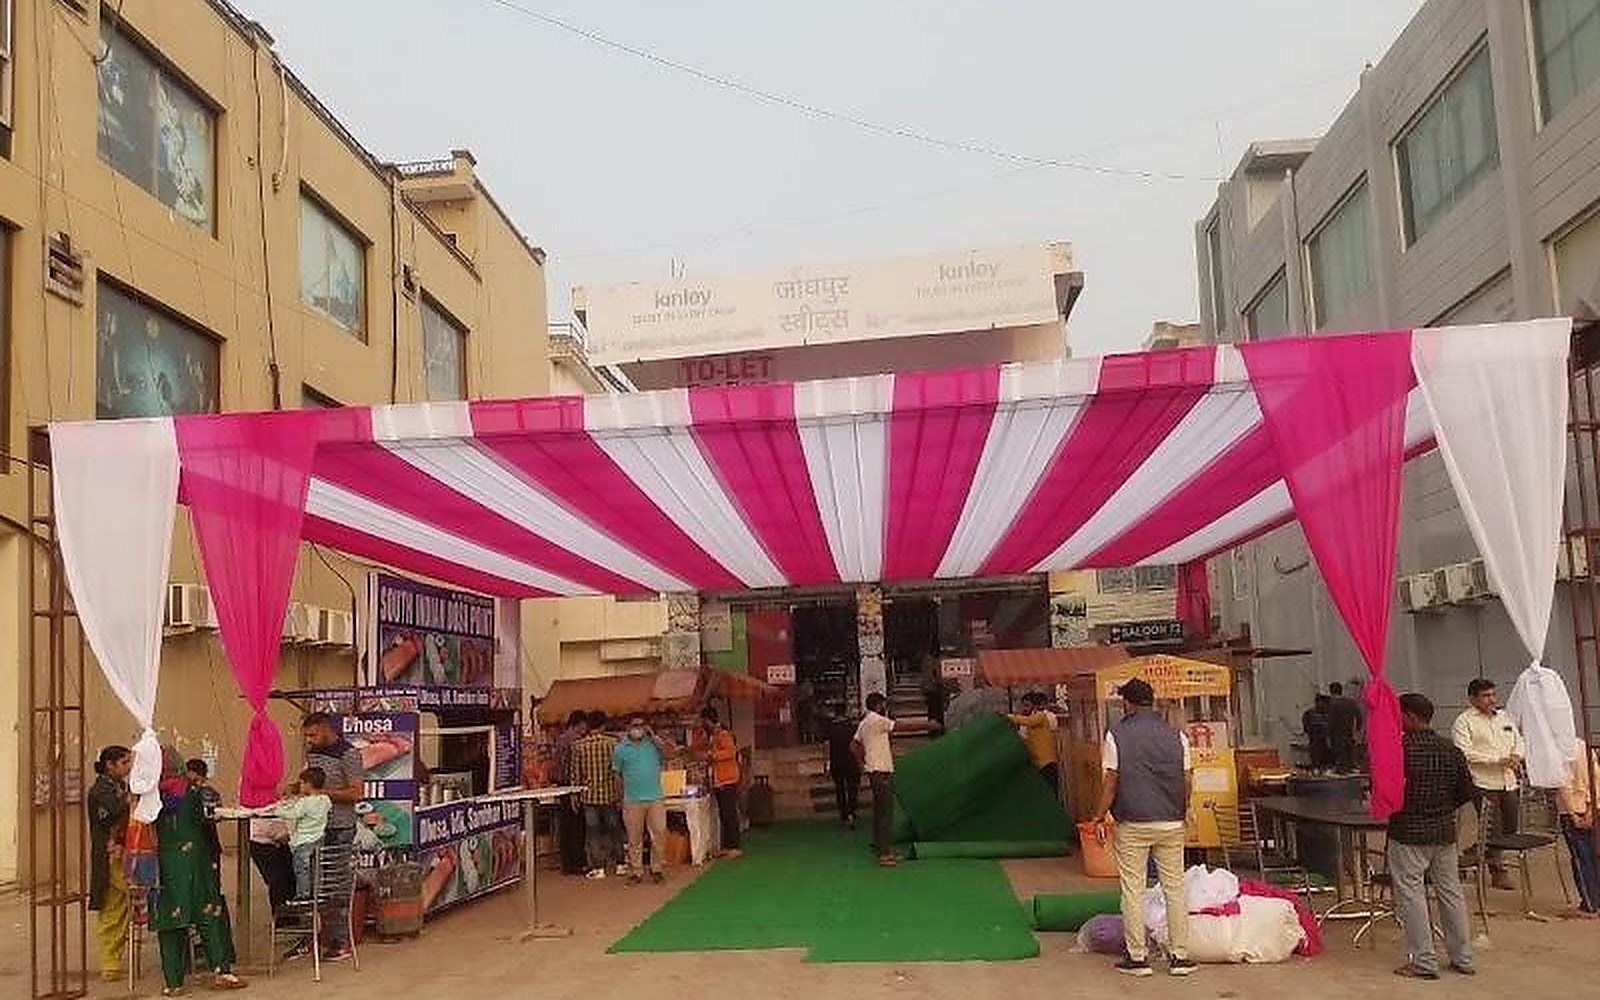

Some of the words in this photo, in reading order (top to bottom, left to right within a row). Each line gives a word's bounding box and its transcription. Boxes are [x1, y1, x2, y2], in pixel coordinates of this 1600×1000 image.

[680, 355, 771, 382] TO-LET
[380, 585, 413, 626] SOUTH
[343, 716, 393, 733] Dhosa
